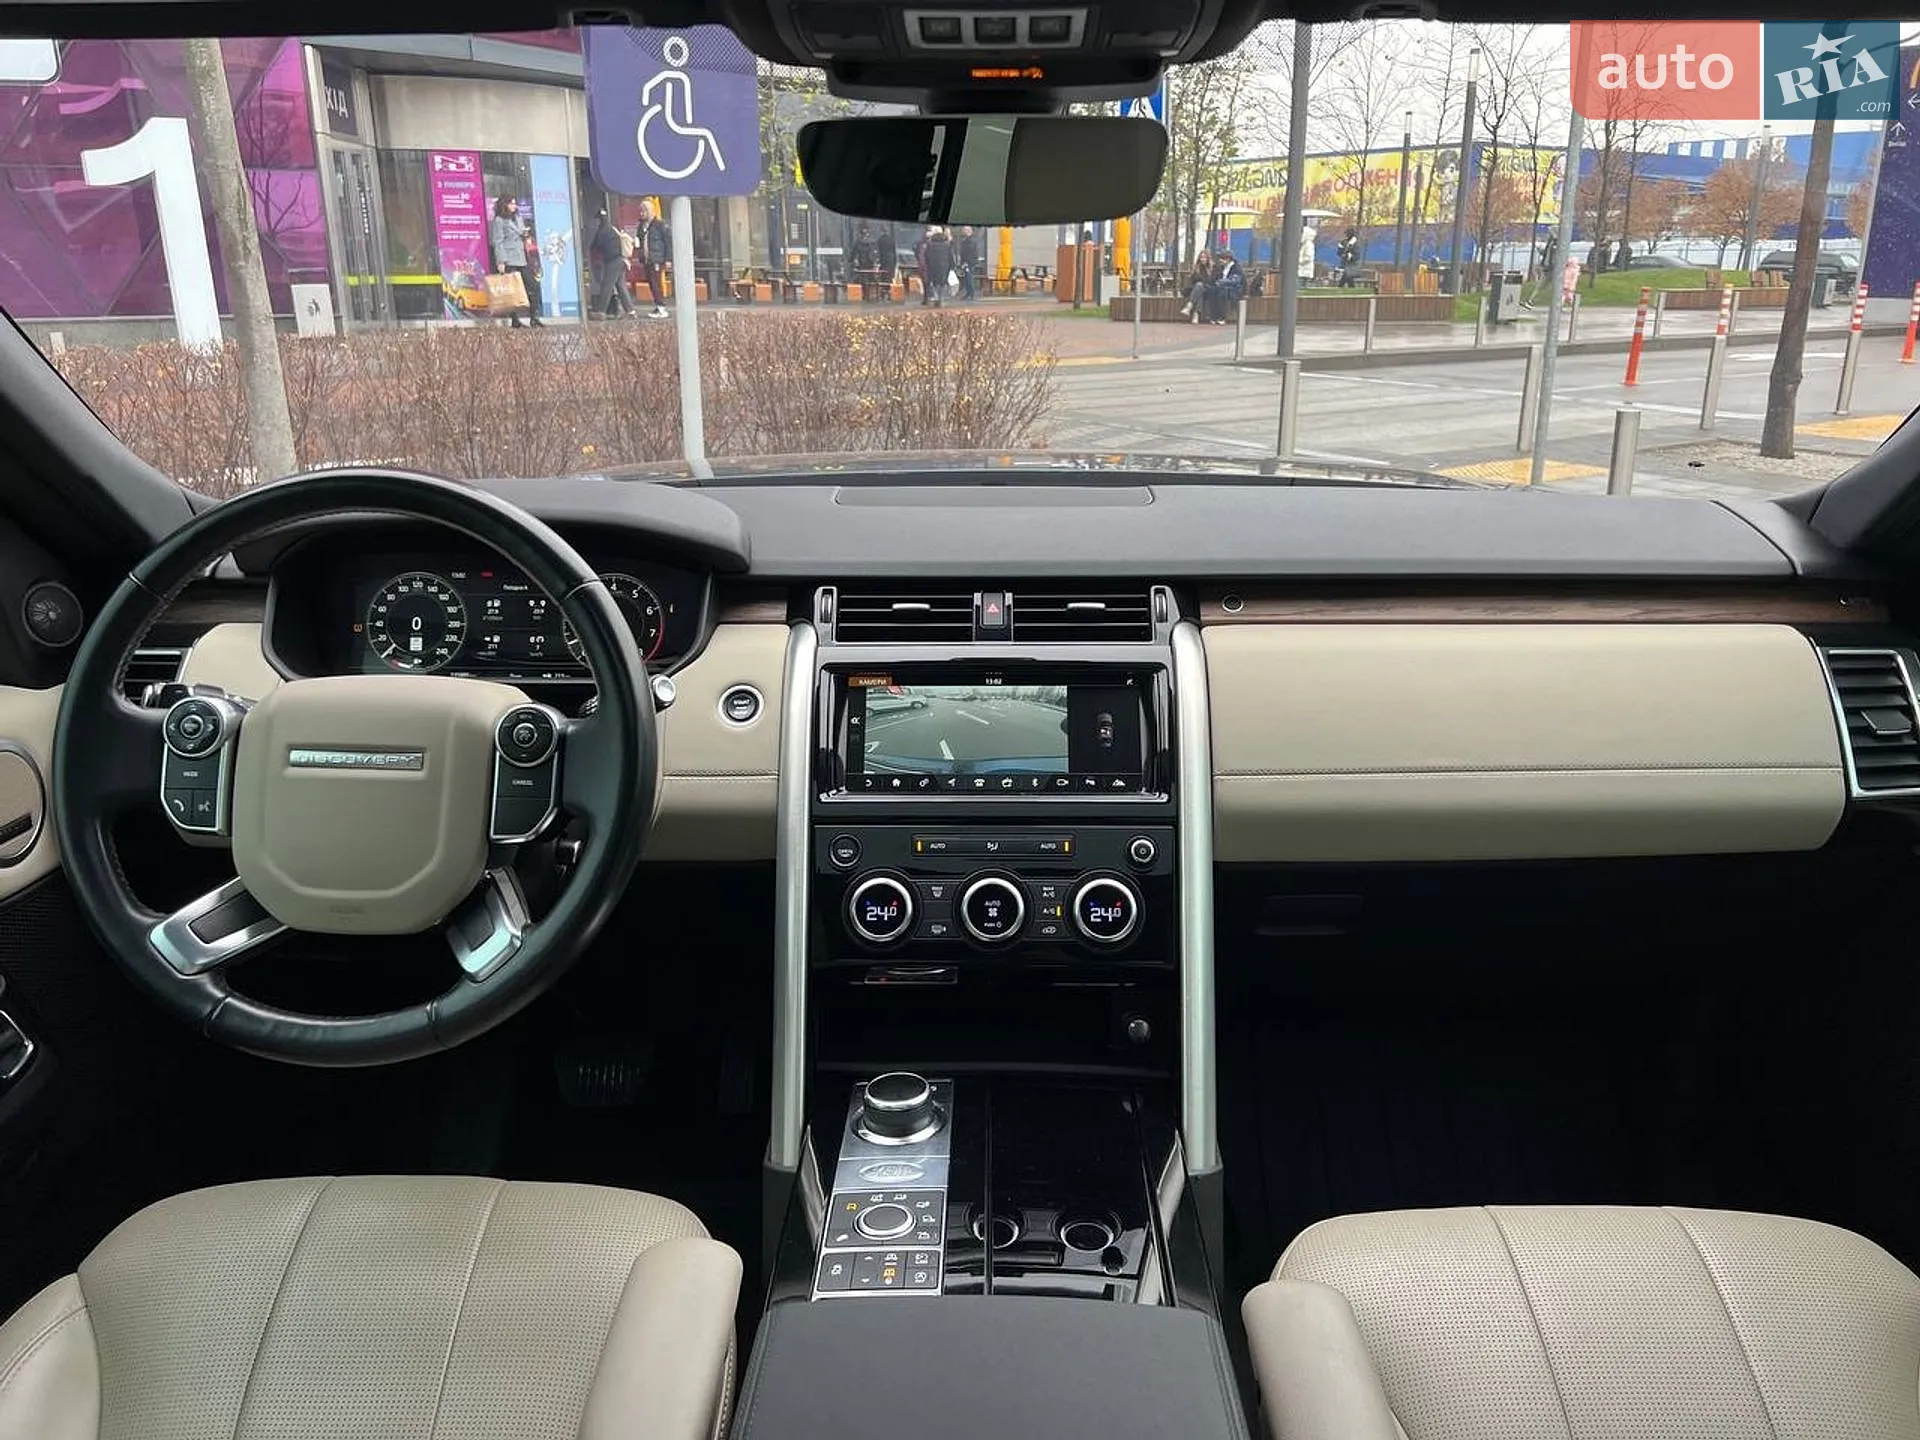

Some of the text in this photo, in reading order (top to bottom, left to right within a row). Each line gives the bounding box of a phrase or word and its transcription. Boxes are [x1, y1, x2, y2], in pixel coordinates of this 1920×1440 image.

[80, 117, 224, 356] 1
[610, 583, 617, 591] 4
[632, 589, 639, 599] 5
[646, 606, 654, 615] 6
[412, 616, 421, 631] 0
[447, 620, 460, 628] 200
[649, 628, 657, 637] 7
[444, 634, 458, 642] 220
